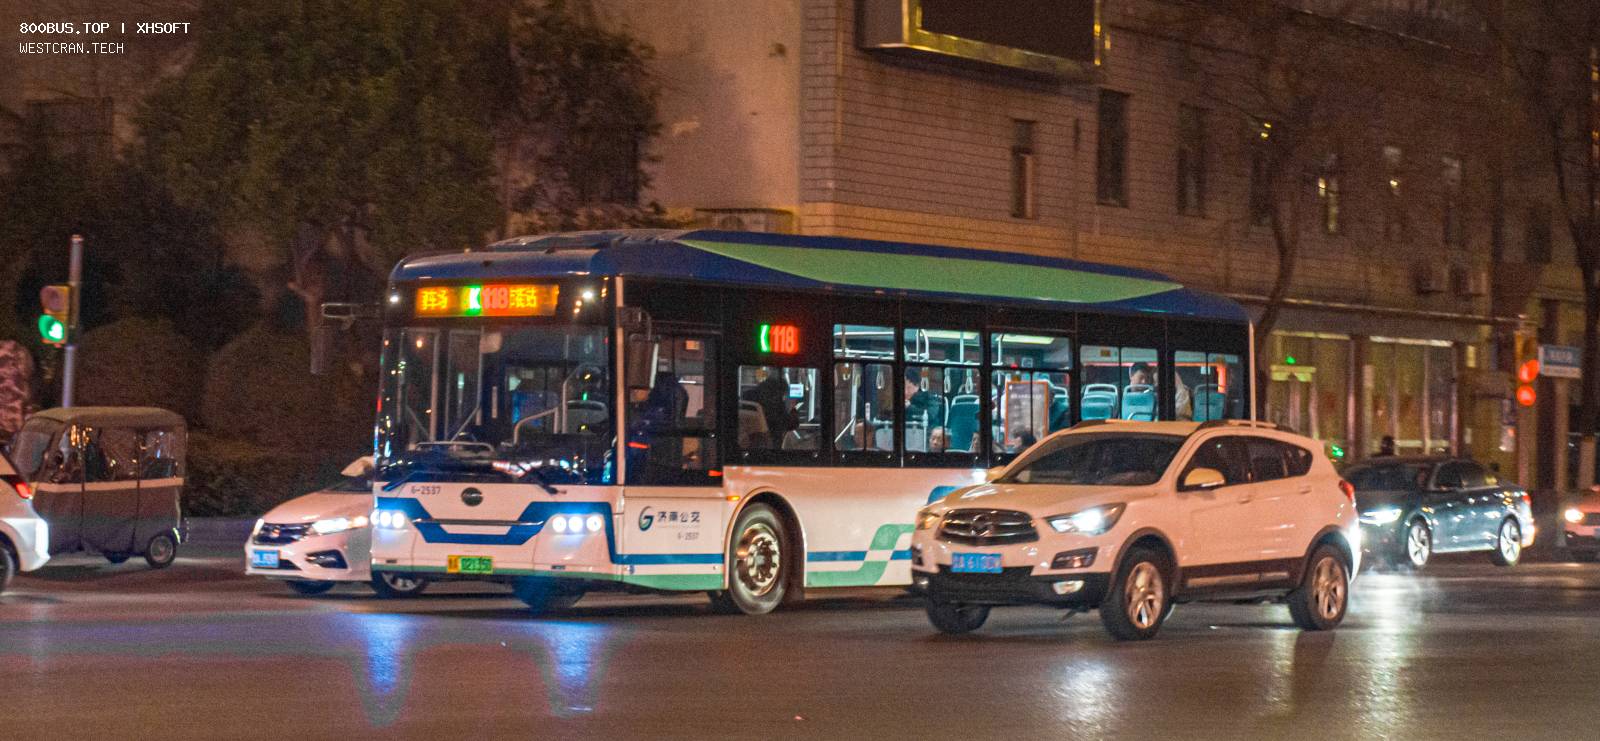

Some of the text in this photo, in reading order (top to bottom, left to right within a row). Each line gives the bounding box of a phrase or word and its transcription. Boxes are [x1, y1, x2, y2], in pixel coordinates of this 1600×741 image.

[411, 485, 441, 495] 6-2537
[658, 511, 700, 523] 济南公交
